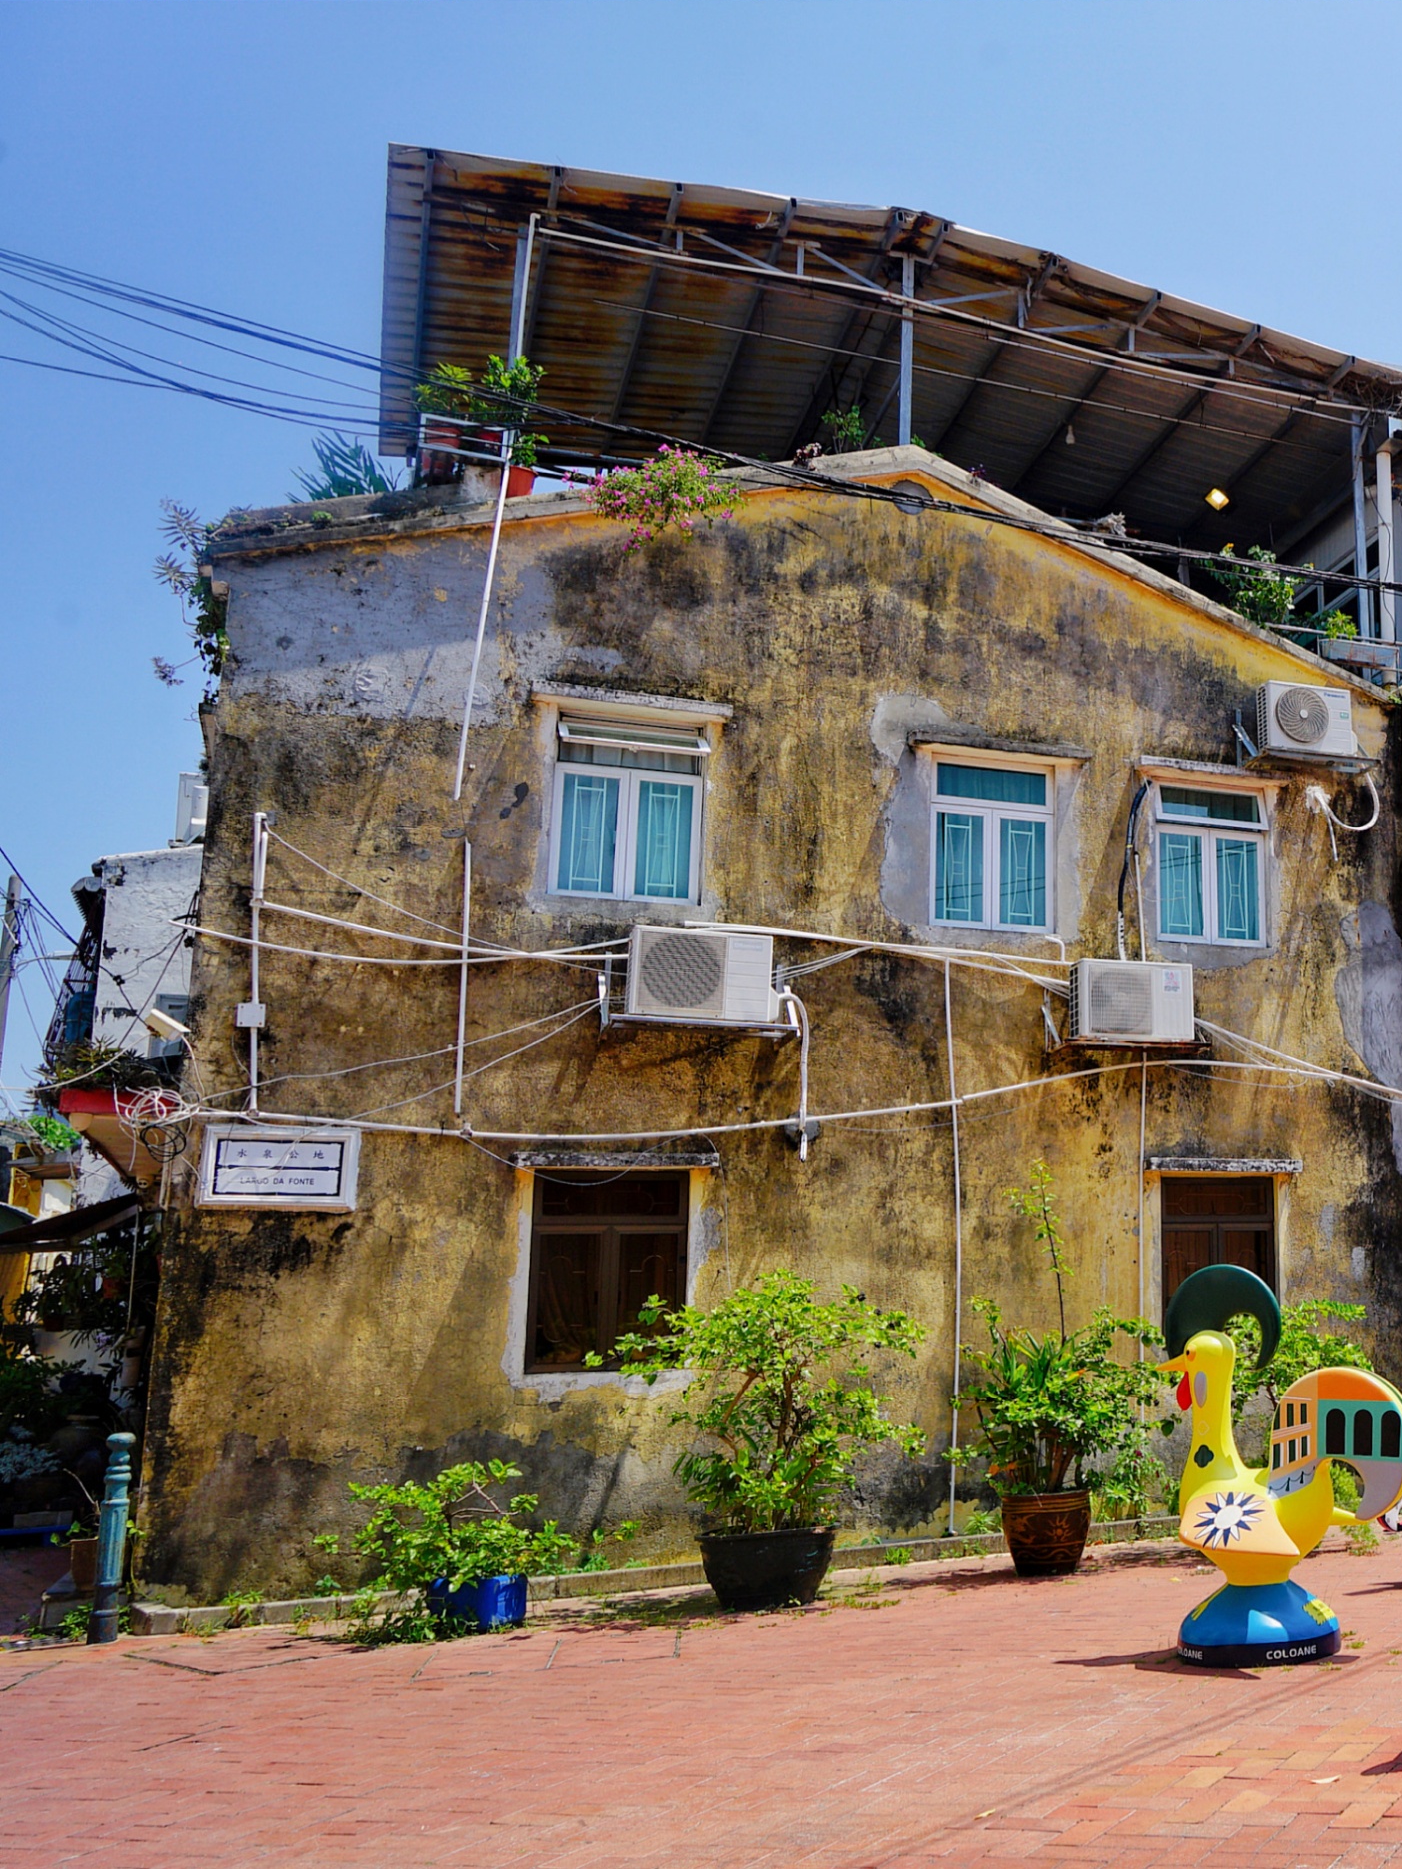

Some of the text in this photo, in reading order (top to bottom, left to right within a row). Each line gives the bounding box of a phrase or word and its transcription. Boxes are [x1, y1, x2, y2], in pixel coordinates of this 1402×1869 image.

[237, 1149, 324, 1159] 水泉公地
[273, 1177, 285, 1185] DA
[288, 1177, 315, 1185] FONTE
[1265, 1644, 1318, 1660] COLOANE
